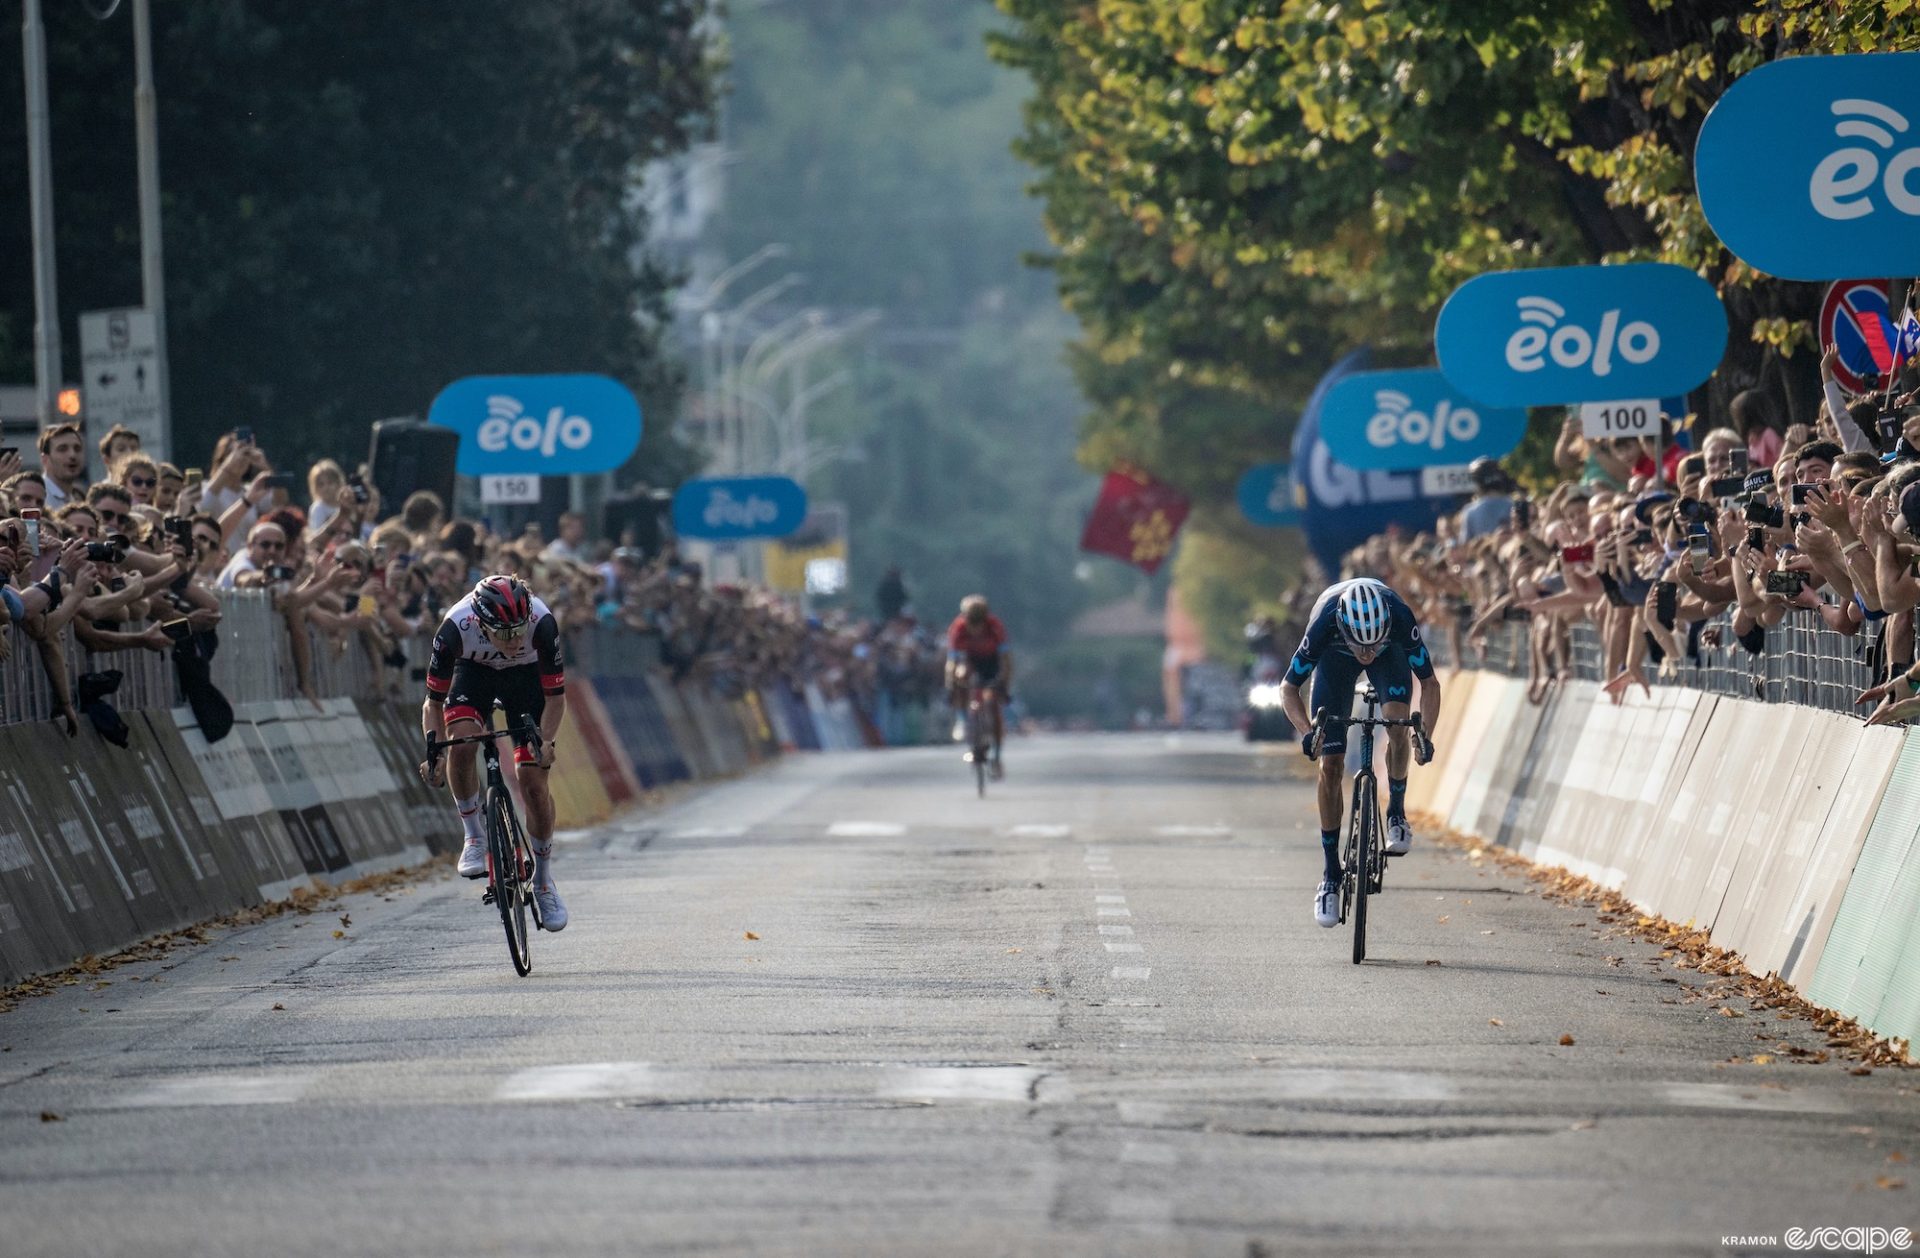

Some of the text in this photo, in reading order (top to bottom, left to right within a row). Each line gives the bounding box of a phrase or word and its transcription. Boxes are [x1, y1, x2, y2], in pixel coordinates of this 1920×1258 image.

[1505, 296, 1660, 376] eolo
[477, 394, 592, 457] eolo
[1366, 389, 1480, 450] eolo
[1600, 407, 1647, 431] 100
[494, 480, 529, 497] 150
